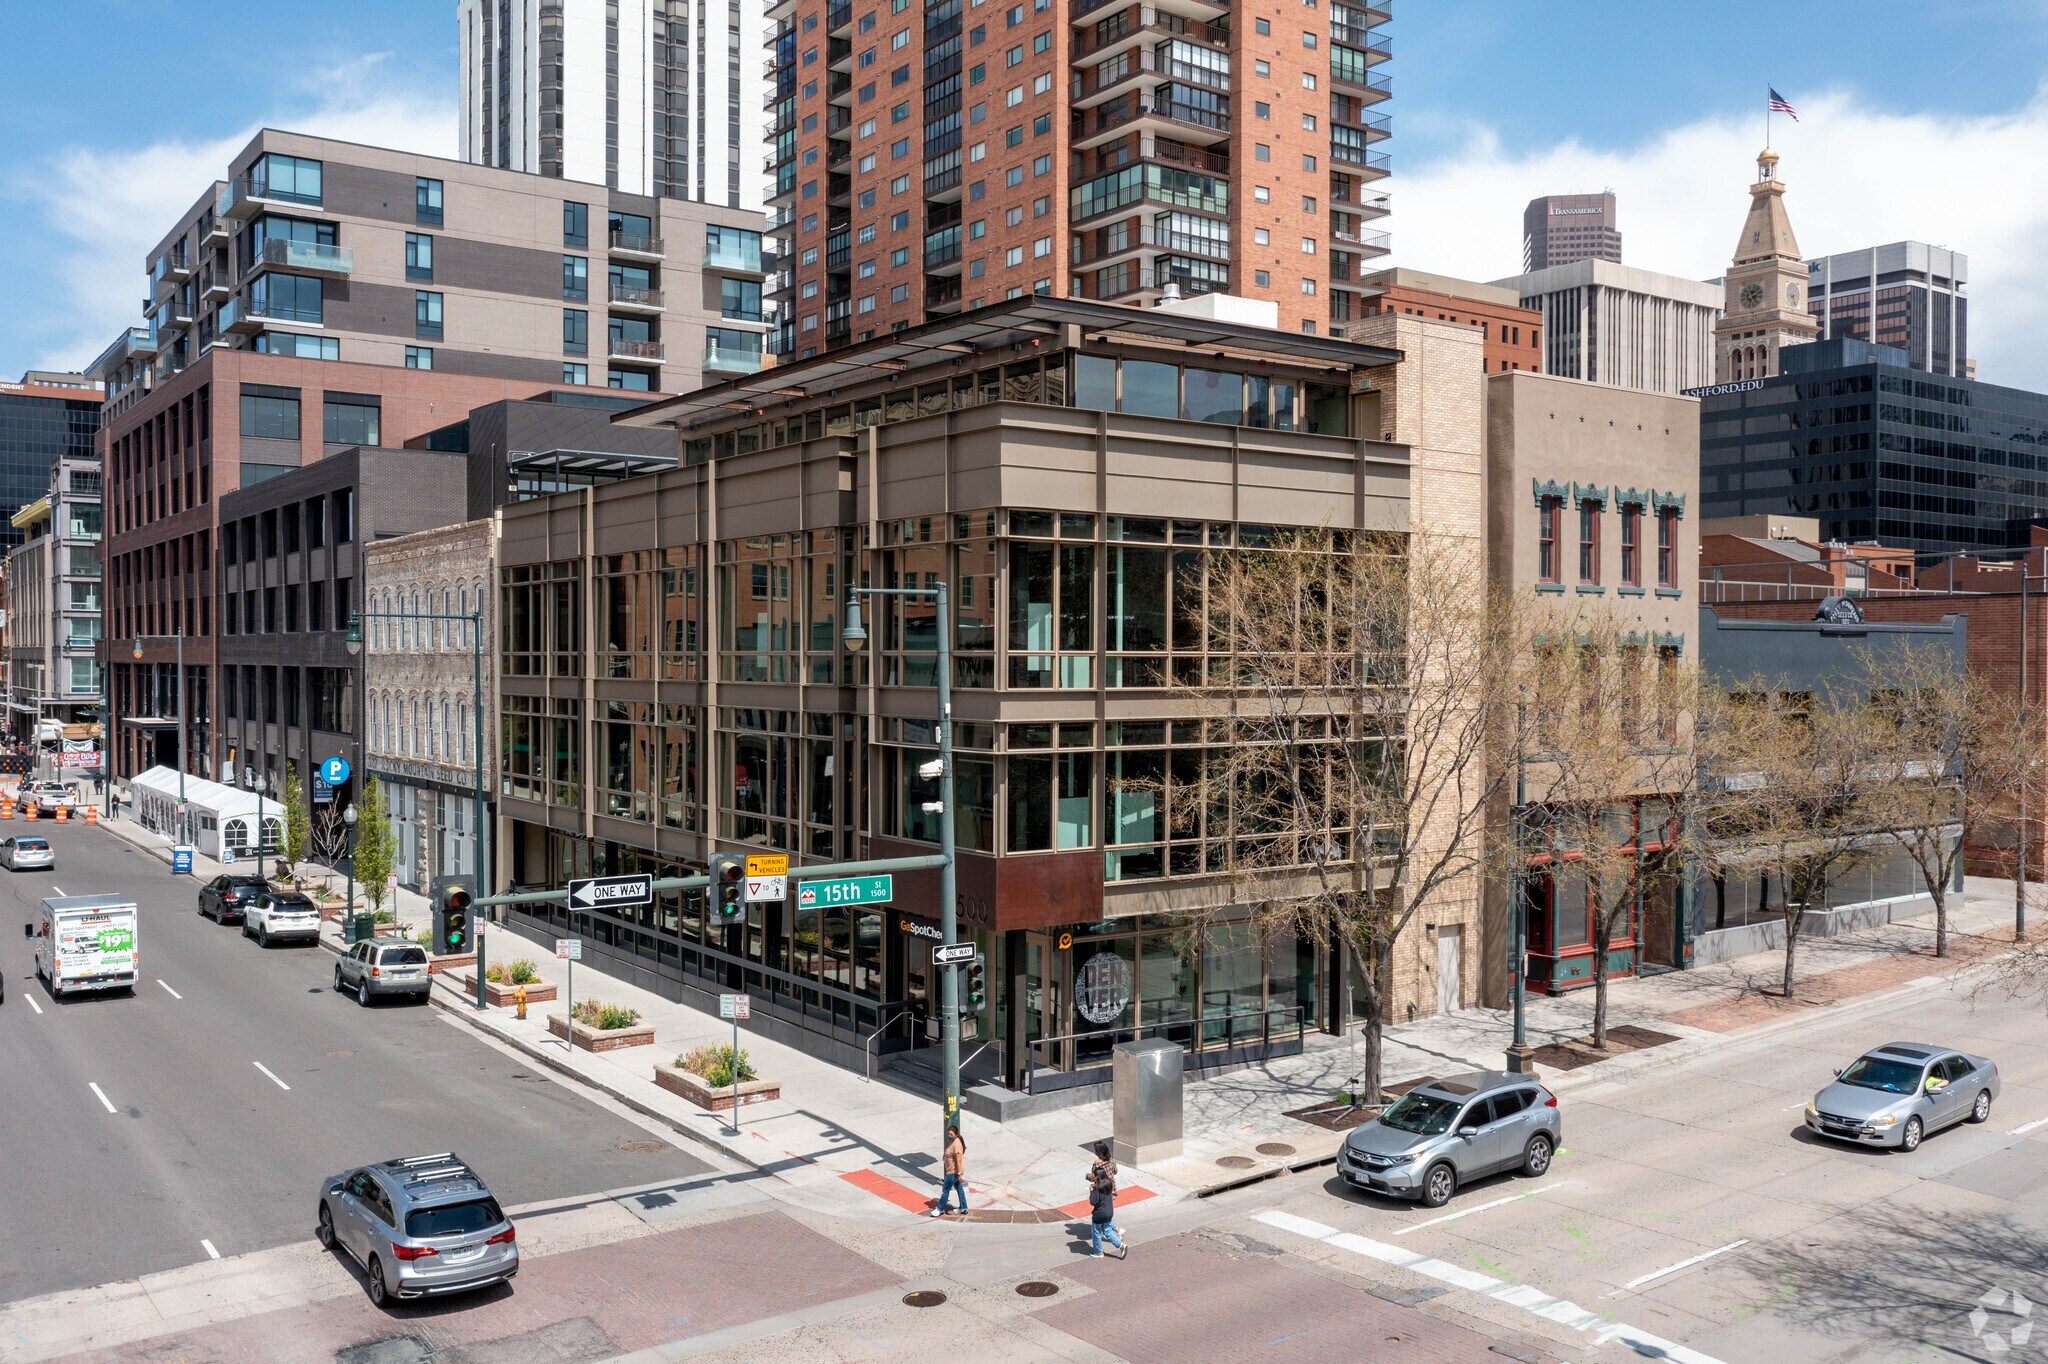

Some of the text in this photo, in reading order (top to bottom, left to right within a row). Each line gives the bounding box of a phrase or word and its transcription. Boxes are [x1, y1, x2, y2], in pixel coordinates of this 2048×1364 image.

[1684, 380, 1764, 398] ASHFORD.EDU
[330, 761, 342, 776] P
[402, 762, 434, 780] MOUNTAIN
[436, 769, 453, 783] SEED
[594, 884, 642, 899] ONE WAY
[824, 882, 861, 902] 15th
[870, 889, 886, 897] 1500
[875, 881, 882, 889] St
[955, 894, 987, 924] 500
[900, 920, 943, 940] GoSpotChe
